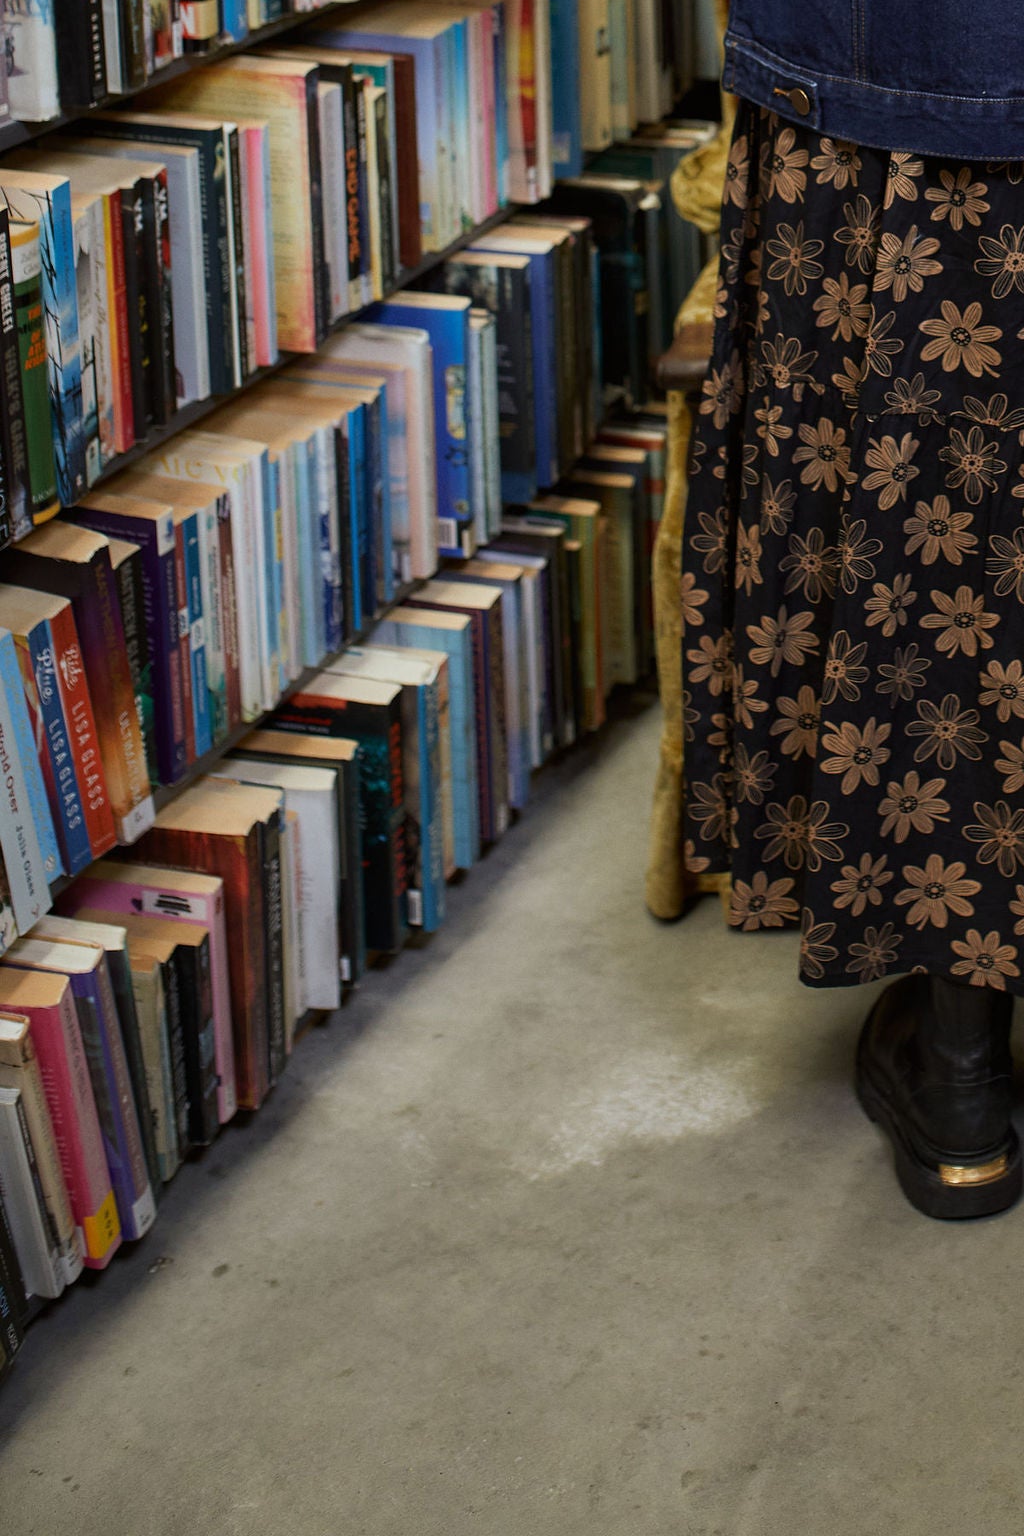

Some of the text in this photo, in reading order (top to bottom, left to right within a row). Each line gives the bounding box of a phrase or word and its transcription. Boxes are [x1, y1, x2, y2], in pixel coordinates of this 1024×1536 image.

[89, 13, 103, 81] GARDNER
[347, 197, 361, 264] GAME
[0, 231, 15, 335] BRENT GHELFI
[10, 419, 26, 473] GAME
[94, 562, 118, 649] MATTHEW
[120, 562, 137, 638] MATTHEW
[48, 718, 82, 831] LISA GLASS
[71, 700, 105, 812] LISA GLASS
[4, 775, 20, 816] Over
[15, 824, 36, 897] Julia Glass
